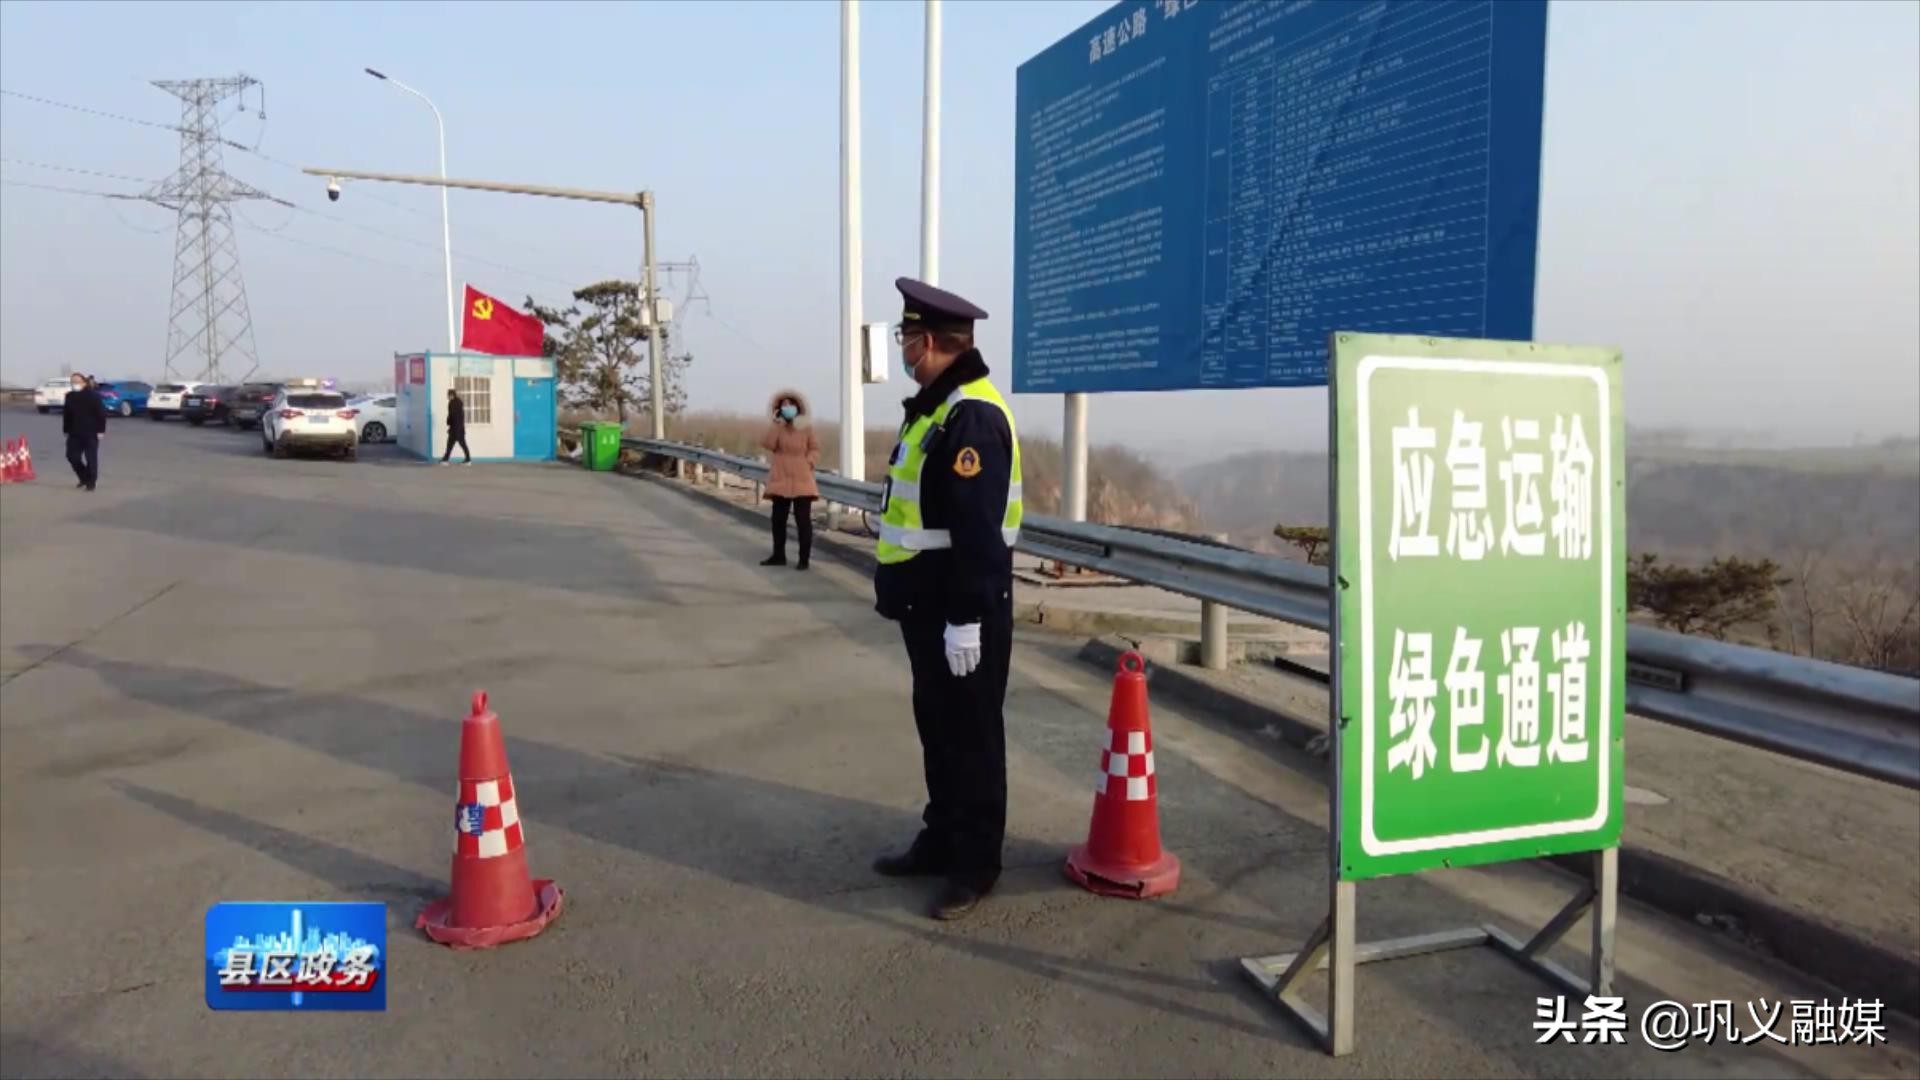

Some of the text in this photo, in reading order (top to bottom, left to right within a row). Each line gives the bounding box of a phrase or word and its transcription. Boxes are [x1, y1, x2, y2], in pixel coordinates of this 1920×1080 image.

[1388, 406, 1594, 561] 应急运输
[1387, 620, 1591, 780] 绿色通道
